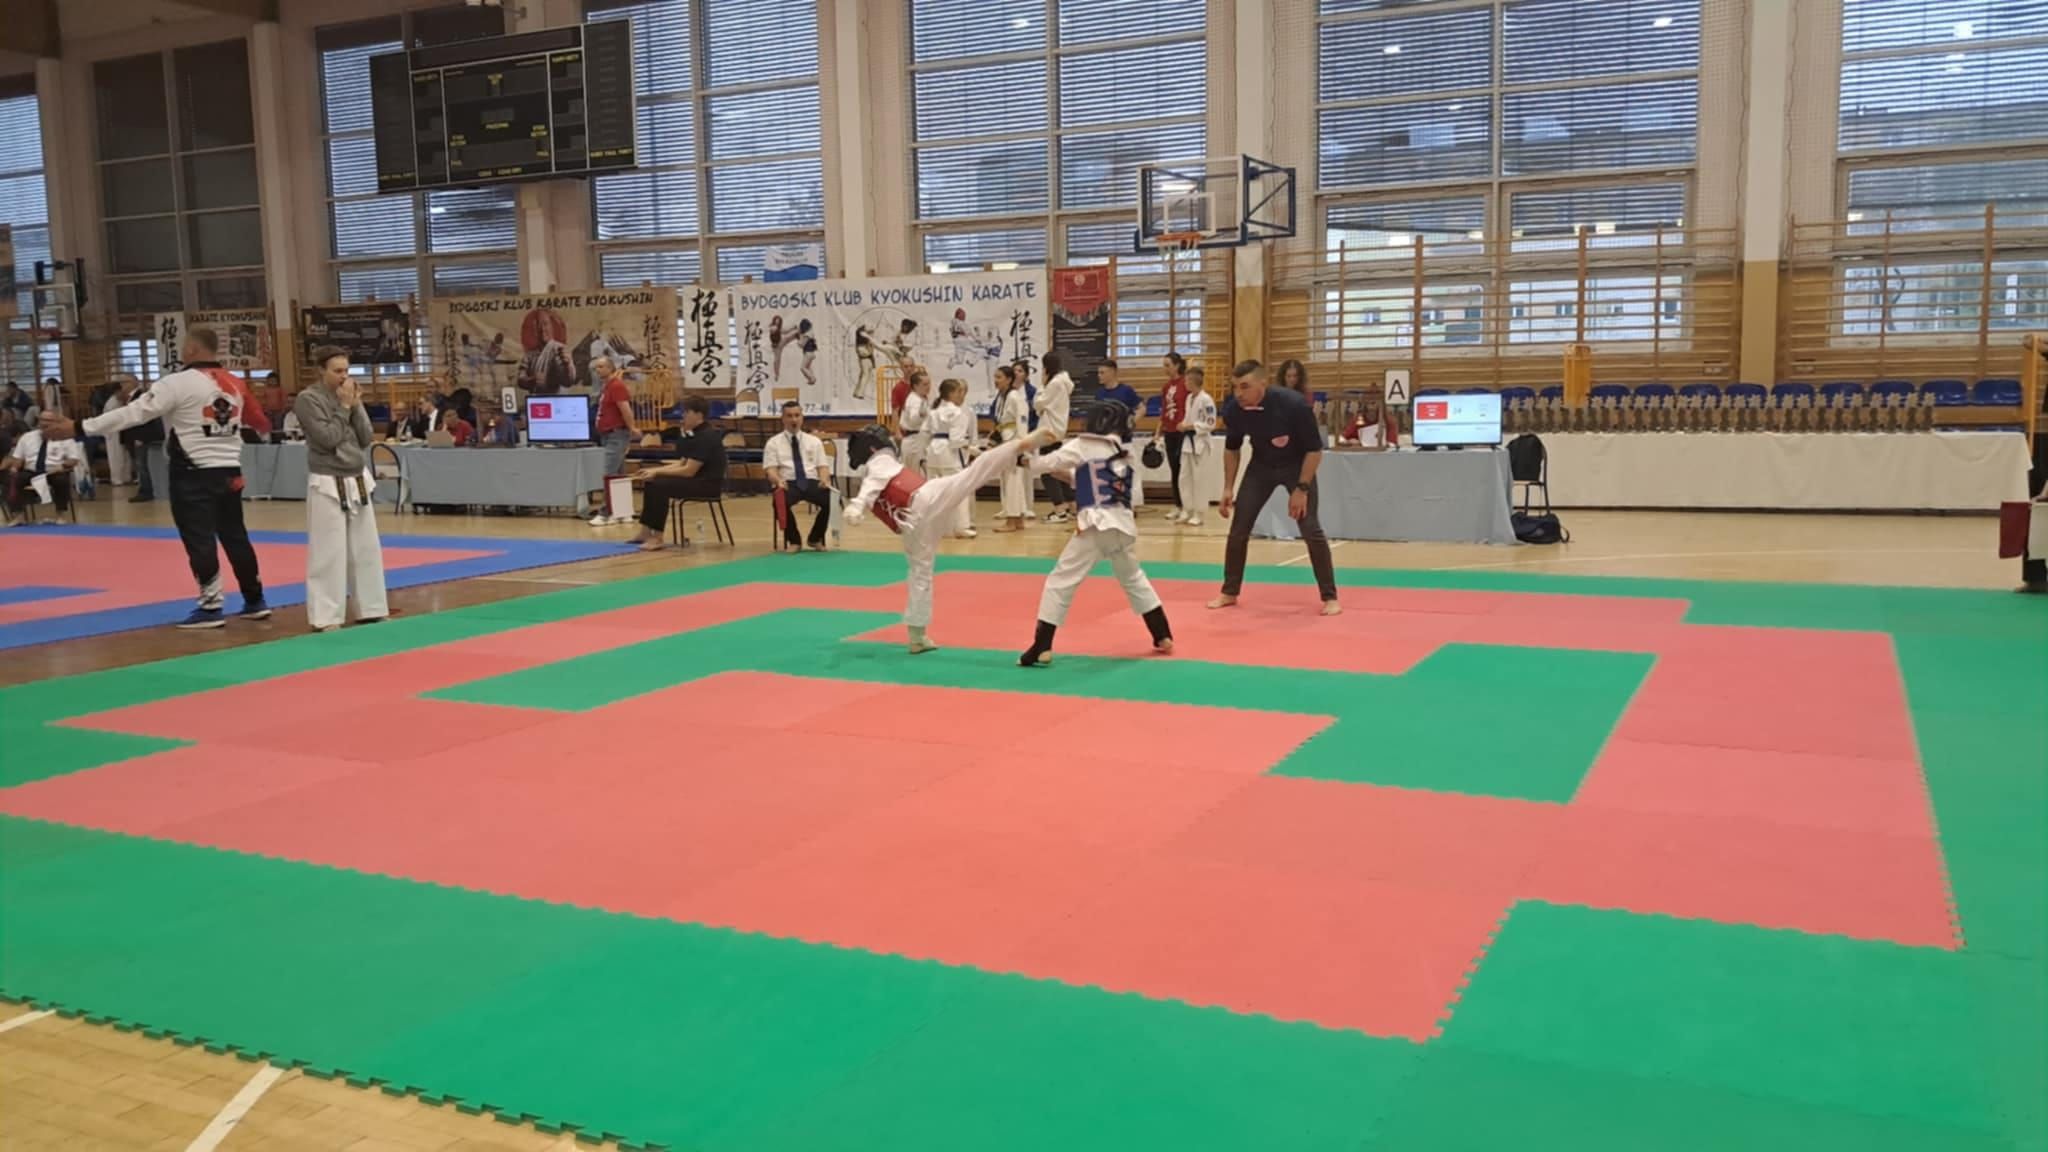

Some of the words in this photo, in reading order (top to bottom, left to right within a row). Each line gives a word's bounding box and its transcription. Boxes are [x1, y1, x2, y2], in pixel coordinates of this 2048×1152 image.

[741, 290, 817, 310] BYDGOSKI
[824, 289, 863, 306] KLUB
[870, 284, 963, 305] KYOKUSHIN
[972, 281, 1037, 300] KARATE
[1388, 378, 1406, 401] A
[505, 393, 514, 410] B
